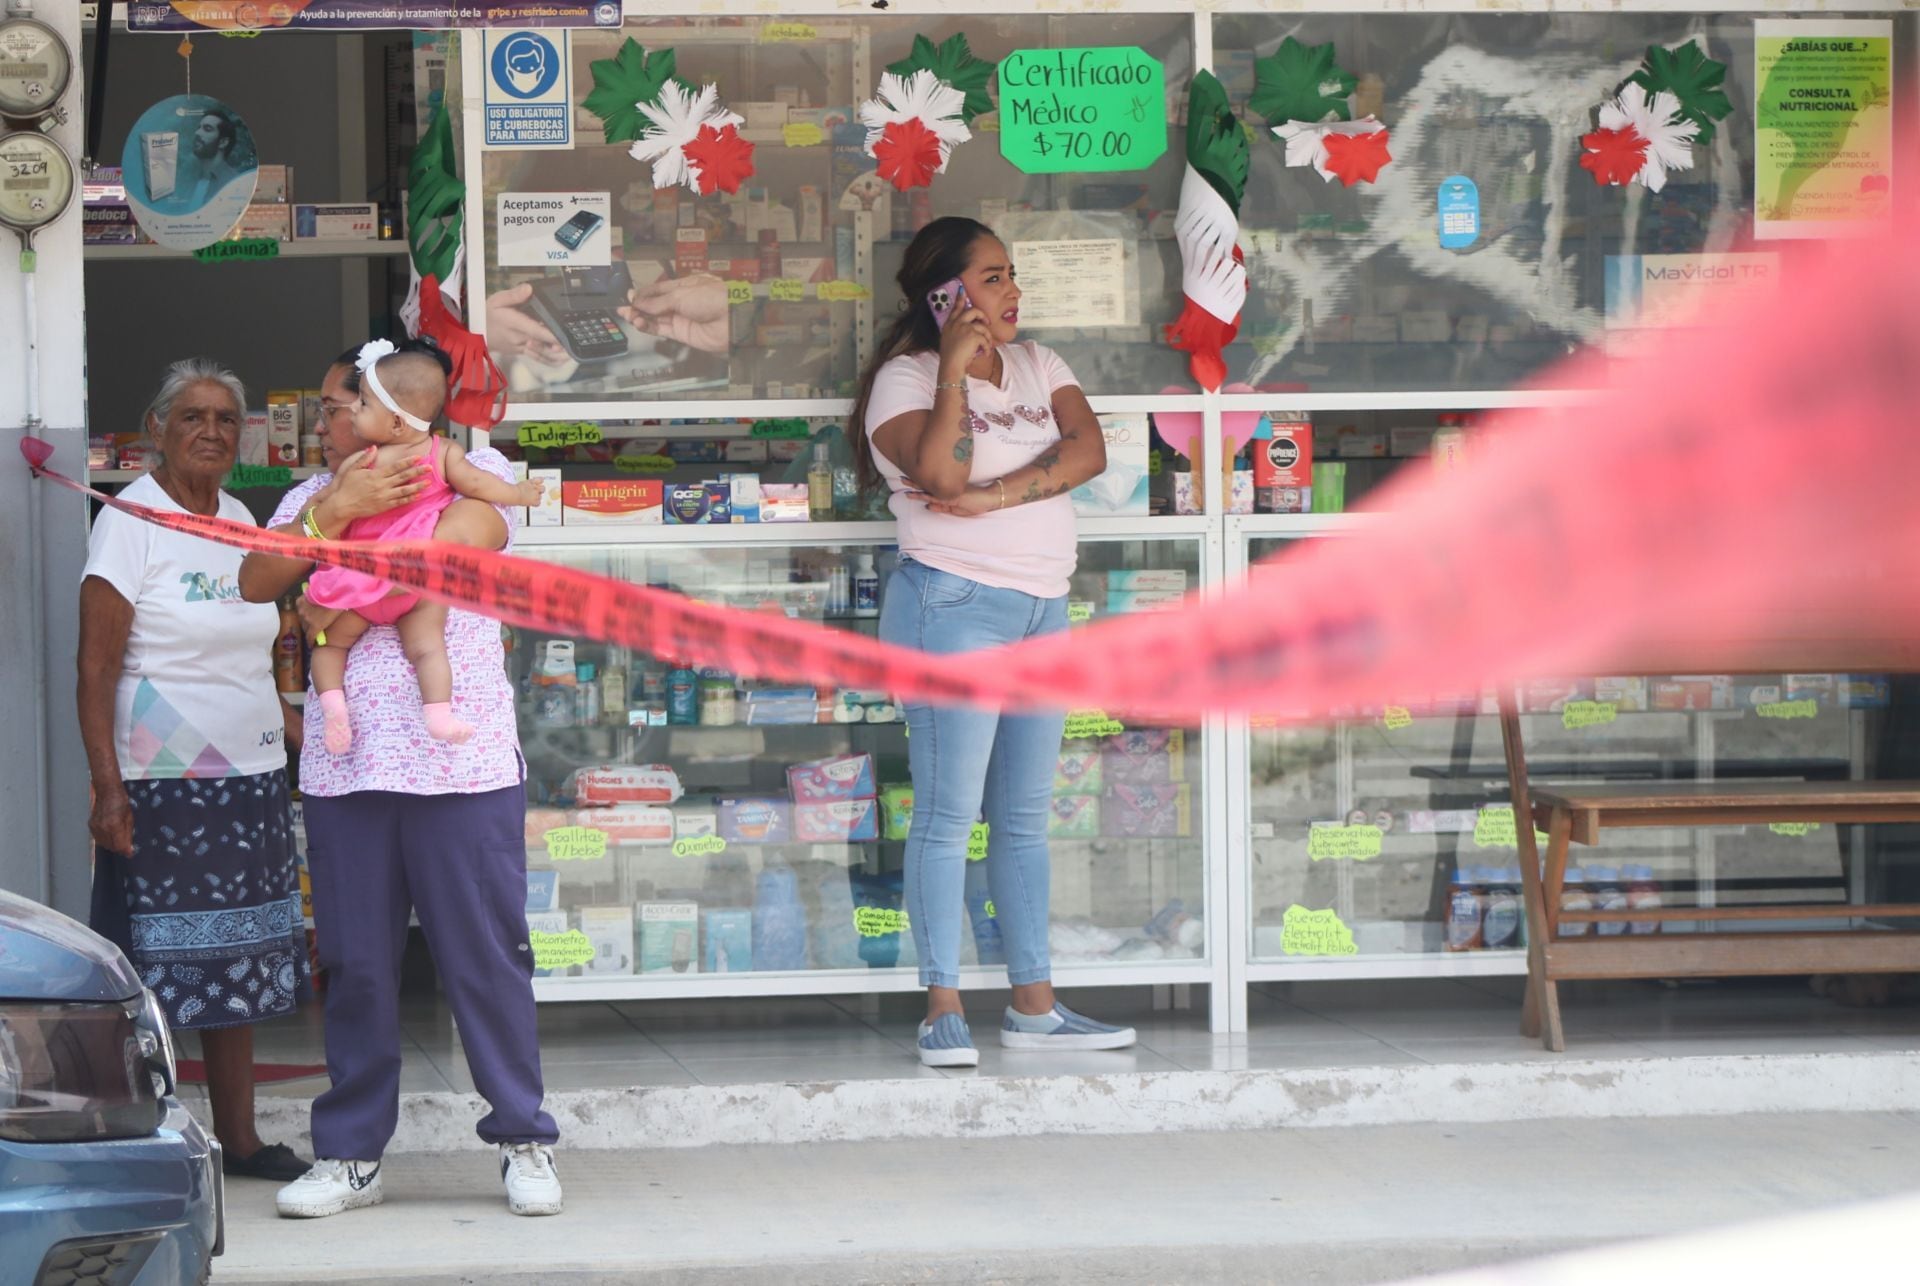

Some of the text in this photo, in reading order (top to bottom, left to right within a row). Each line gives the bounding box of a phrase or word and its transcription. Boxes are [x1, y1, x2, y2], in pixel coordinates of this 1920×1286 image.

[300, 10, 328, 21] Ayuda
[337, 9, 346, 19] la
[347, 9, 397, 21] prevención
[405, 8, 458, 18] tratamiento
[460, 8, 472, 18] de
[473, 8, 481, 17] la
[488, 8, 511, 18] gripe
[519, 7, 557, 17] resfriado
[559, 7, 589, 17] común
[1781, 40, 1868, 54] ¿SABÍAS QUE...?
[1003, 51, 1152, 88] Certificado
[1789, 89, 1851, 98] CONSULTA
[490, 108, 563, 118] USO OBLIGATORIO
[1012, 92, 1098, 125] Médico
[1780, 102, 1858, 111] NUTRICIONAL
[490, 119, 564, 130] DE CUBREBOCAS
[490, 129, 564, 140] PARA INGRESAR
[9, 162, 48, 178] 3209
[503, 199, 563, 212] Aceptamos
[503, 214, 555, 226] pagos con
[546, 251, 569, 260] VISA
[1646, 264, 1769, 281] Mavidol TR
[522, 426, 601, 447] Indigestión
[579, 483, 647, 501] Ampigrin
[673, 490, 704, 500] QG5
[548, 829, 602, 843] Toallitas
[1288, 911, 1332, 924] Suerox
